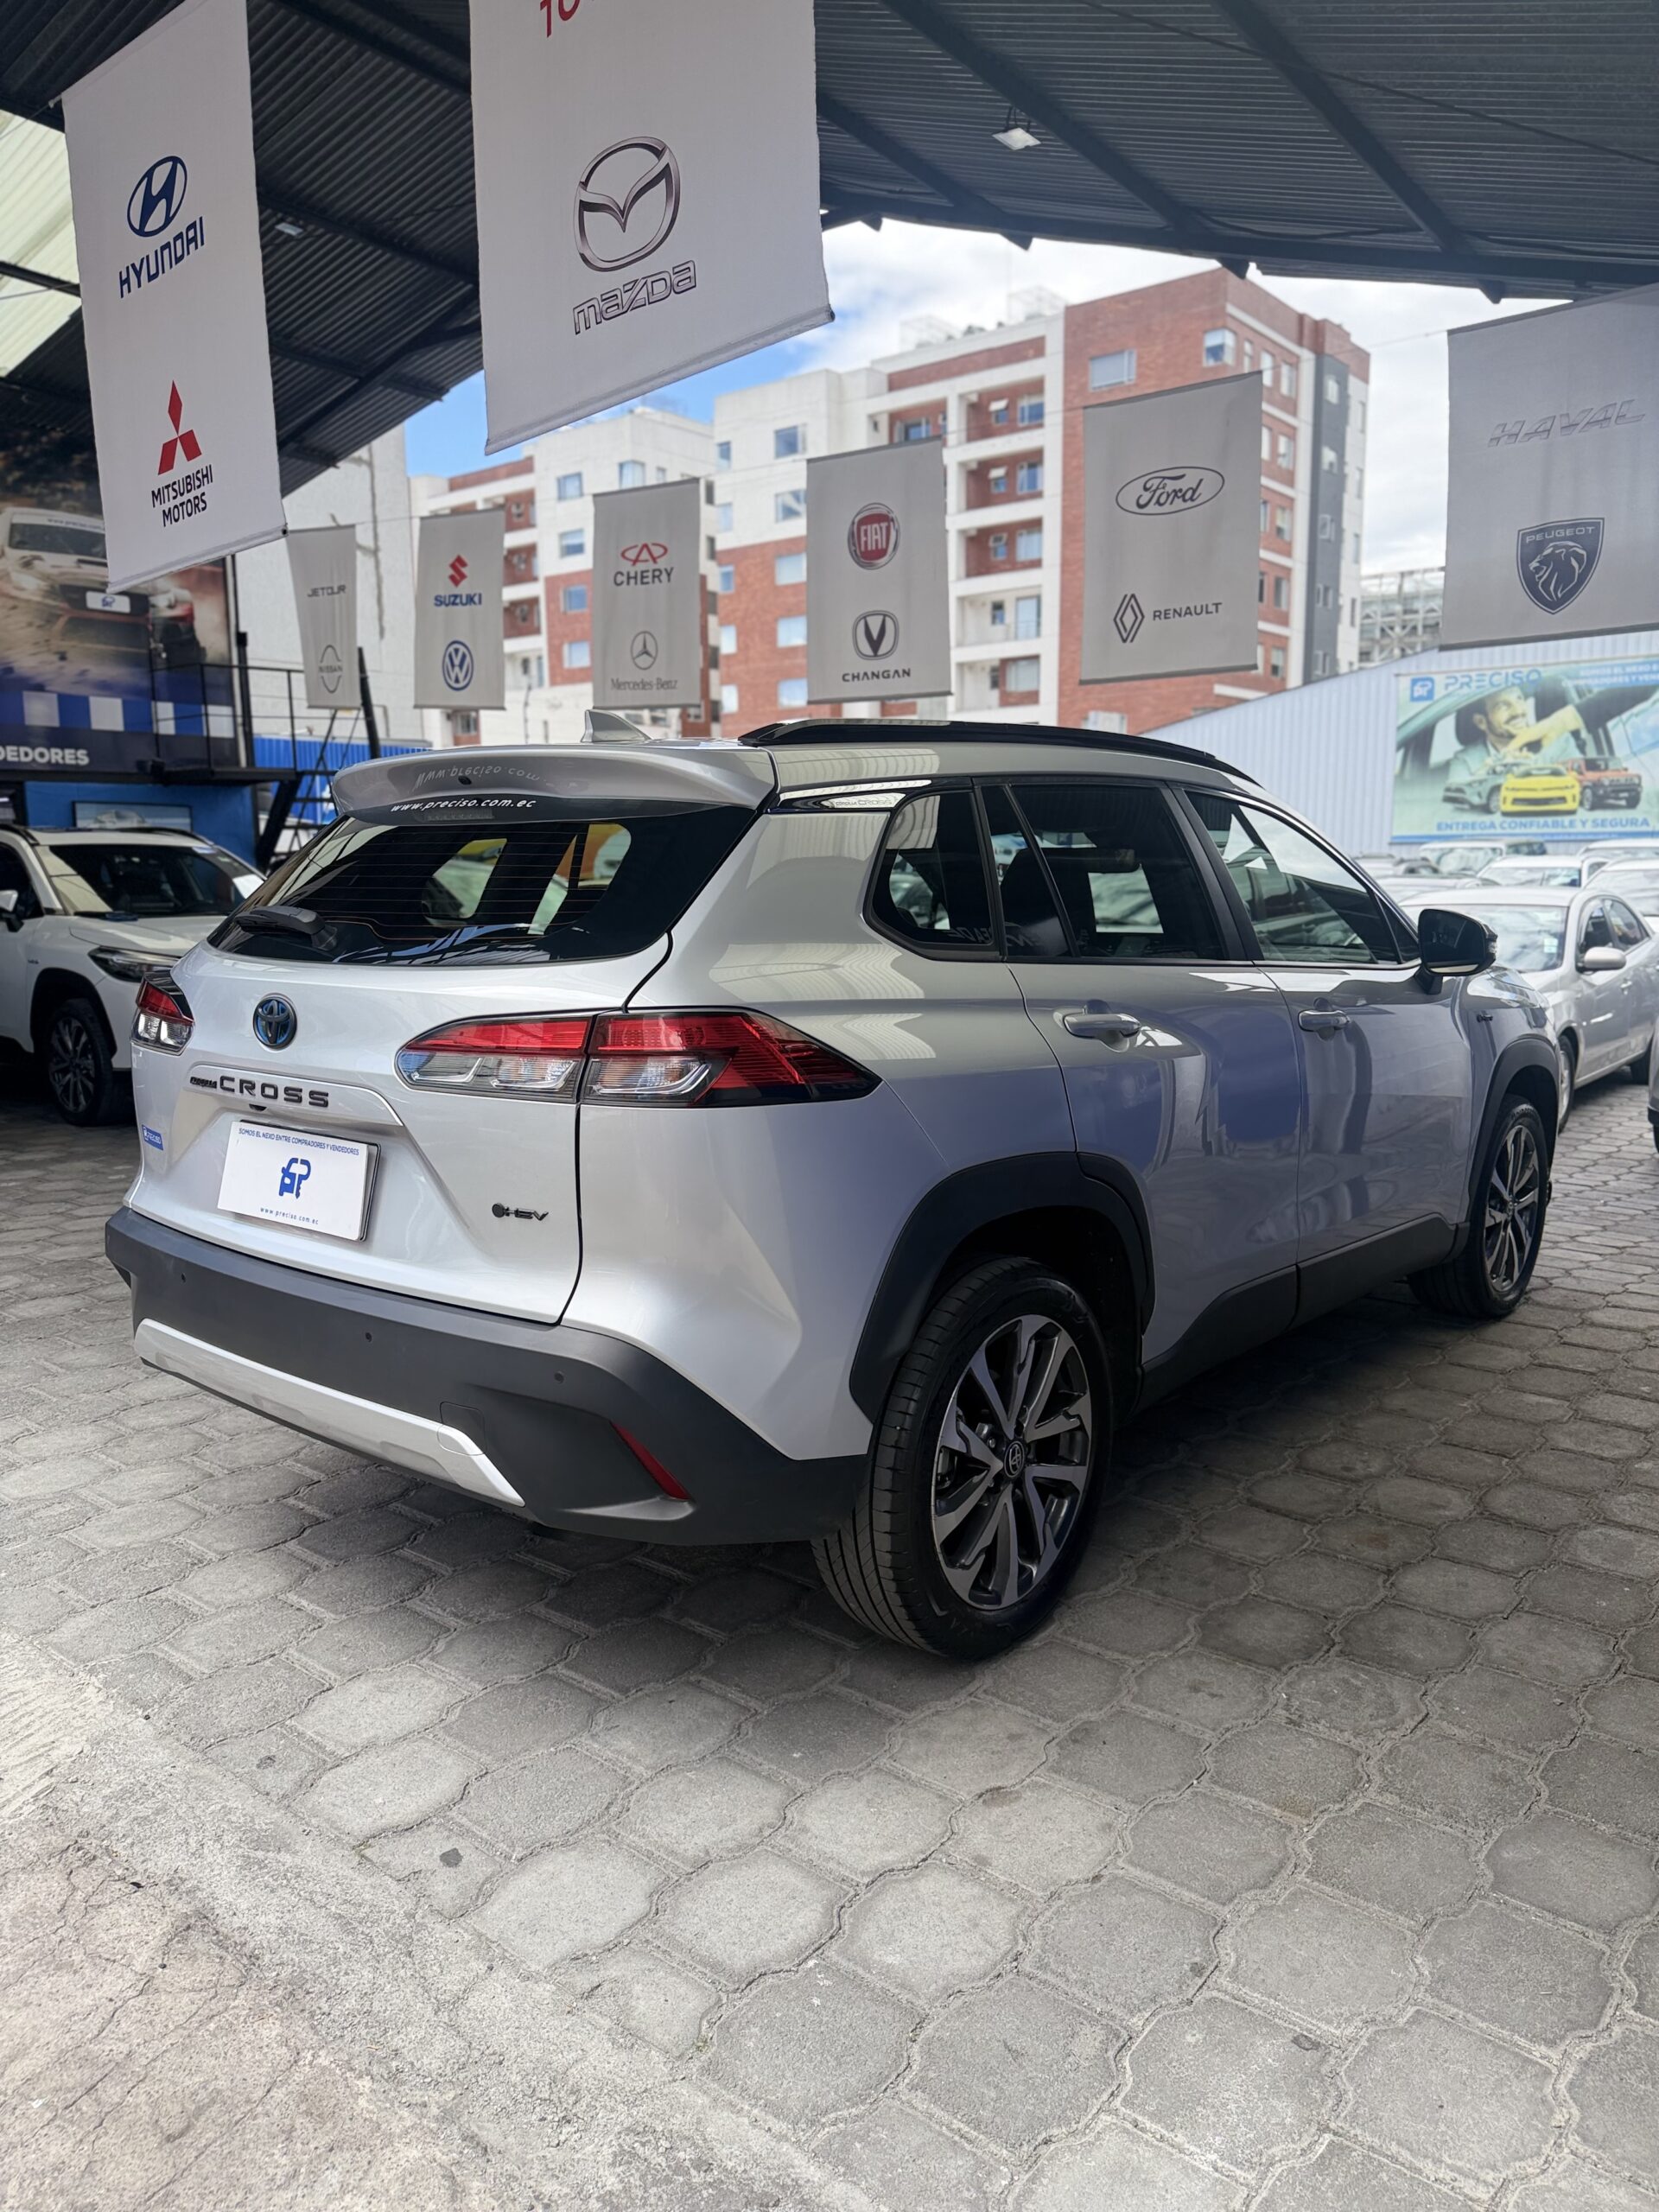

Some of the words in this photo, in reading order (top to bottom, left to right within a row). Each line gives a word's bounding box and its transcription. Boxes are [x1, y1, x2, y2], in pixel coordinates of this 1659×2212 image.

[118, 216, 205, 299] HYUNDAI
[1487, 398, 1646, 448] HAVAL
[150, 463, 213, 508] MITSUBISHI
[1135, 473, 1204, 509] Ford
[162, 491, 207, 528] MOTORS
[859, 522, 891, 553] FIAT
[1525, 525, 1596, 544] PEUGEOT
[613, 567, 674, 588] CHERY
[307, 584, 346, 598] JETOUR
[433, 593, 482, 607] SUZUKI
[1152, 601, 1223, 621] RENAULT
[610, 677, 678, 691] Mercedes-Benz
[842, 667, 912, 683] CHANGAN
[1444, 669, 1542, 691] PRECISO
[390, 798, 537, 812] www.preciso.com.ec
[1436, 820, 1498, 832] ENTREGA
[1500, 819, 1576, 830] CONFIABLE
[1578, 818, 1589, 830] Y
[1592, 817, 1650, 829] SEGURA
[219, 1075, 329, 1108] CROSS
[238, 1128, 256, 1137] SOMOS
[261, 1131, 276, 1141] NEXO
[275, 1134, 291, 1143] ENTRE
[291, 1136, 326, 1150] COMPRADORES
[329, 1143, 359, 1156] VENDEDORES
